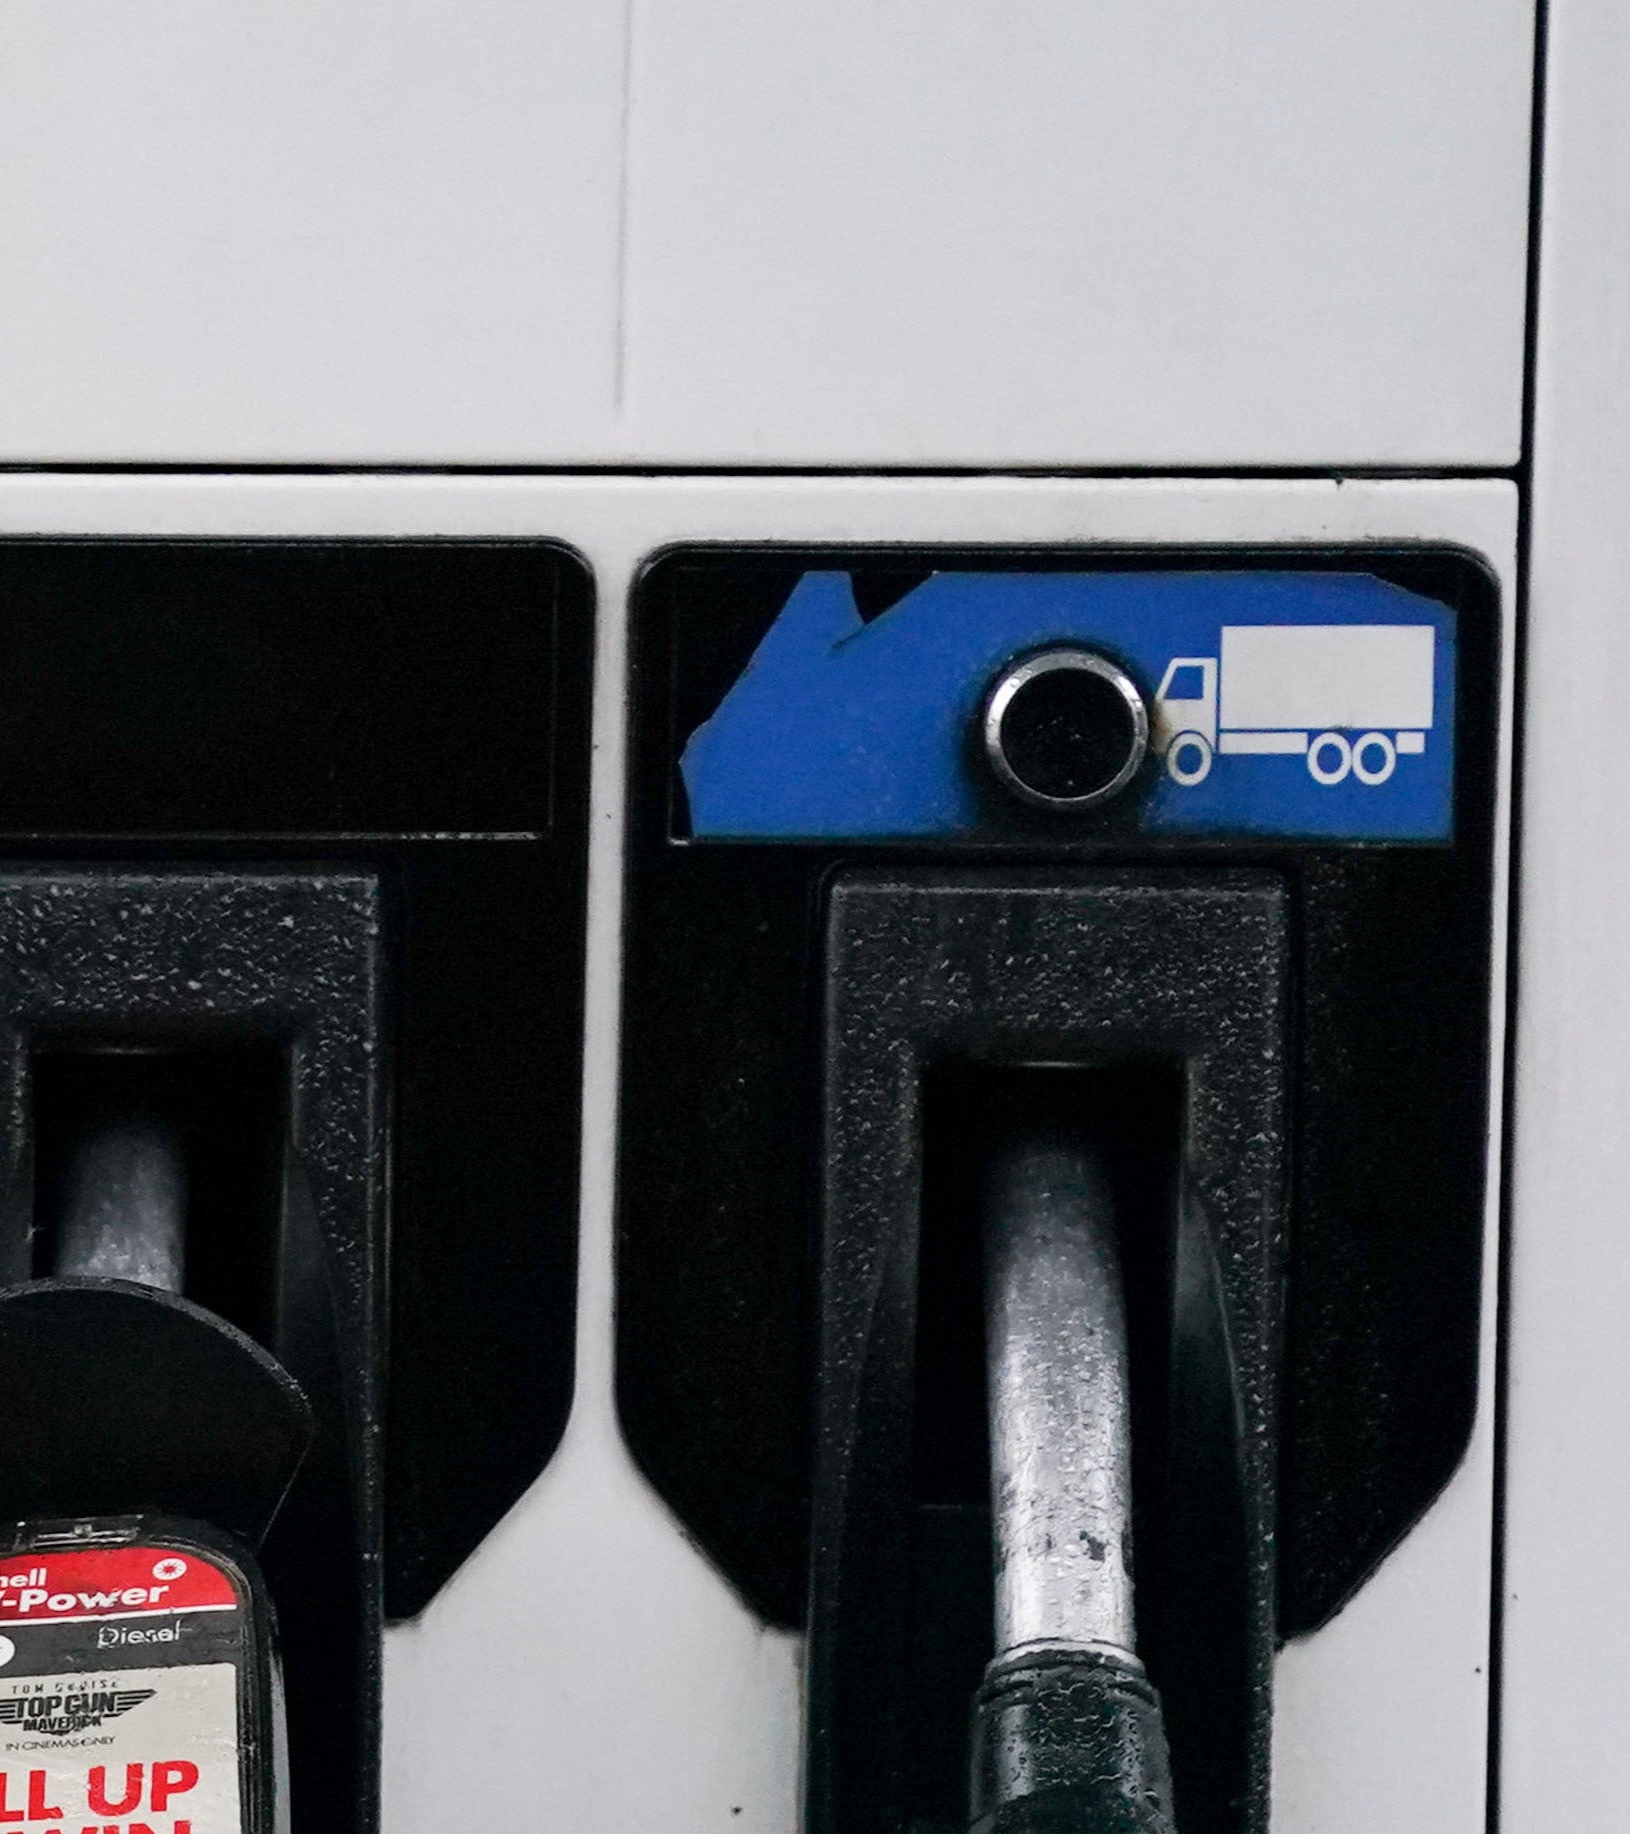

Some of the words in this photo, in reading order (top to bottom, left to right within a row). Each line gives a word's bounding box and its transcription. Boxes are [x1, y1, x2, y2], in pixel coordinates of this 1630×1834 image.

[97, 1620, 181, 1648] Diesel
[15, 1695, 62, 1719] TOP
[63, 1691, 117, 1714] GUN
[22, 1713, 103, 1732] MAVERICK
[87, 1760, 199, 1817] UP
